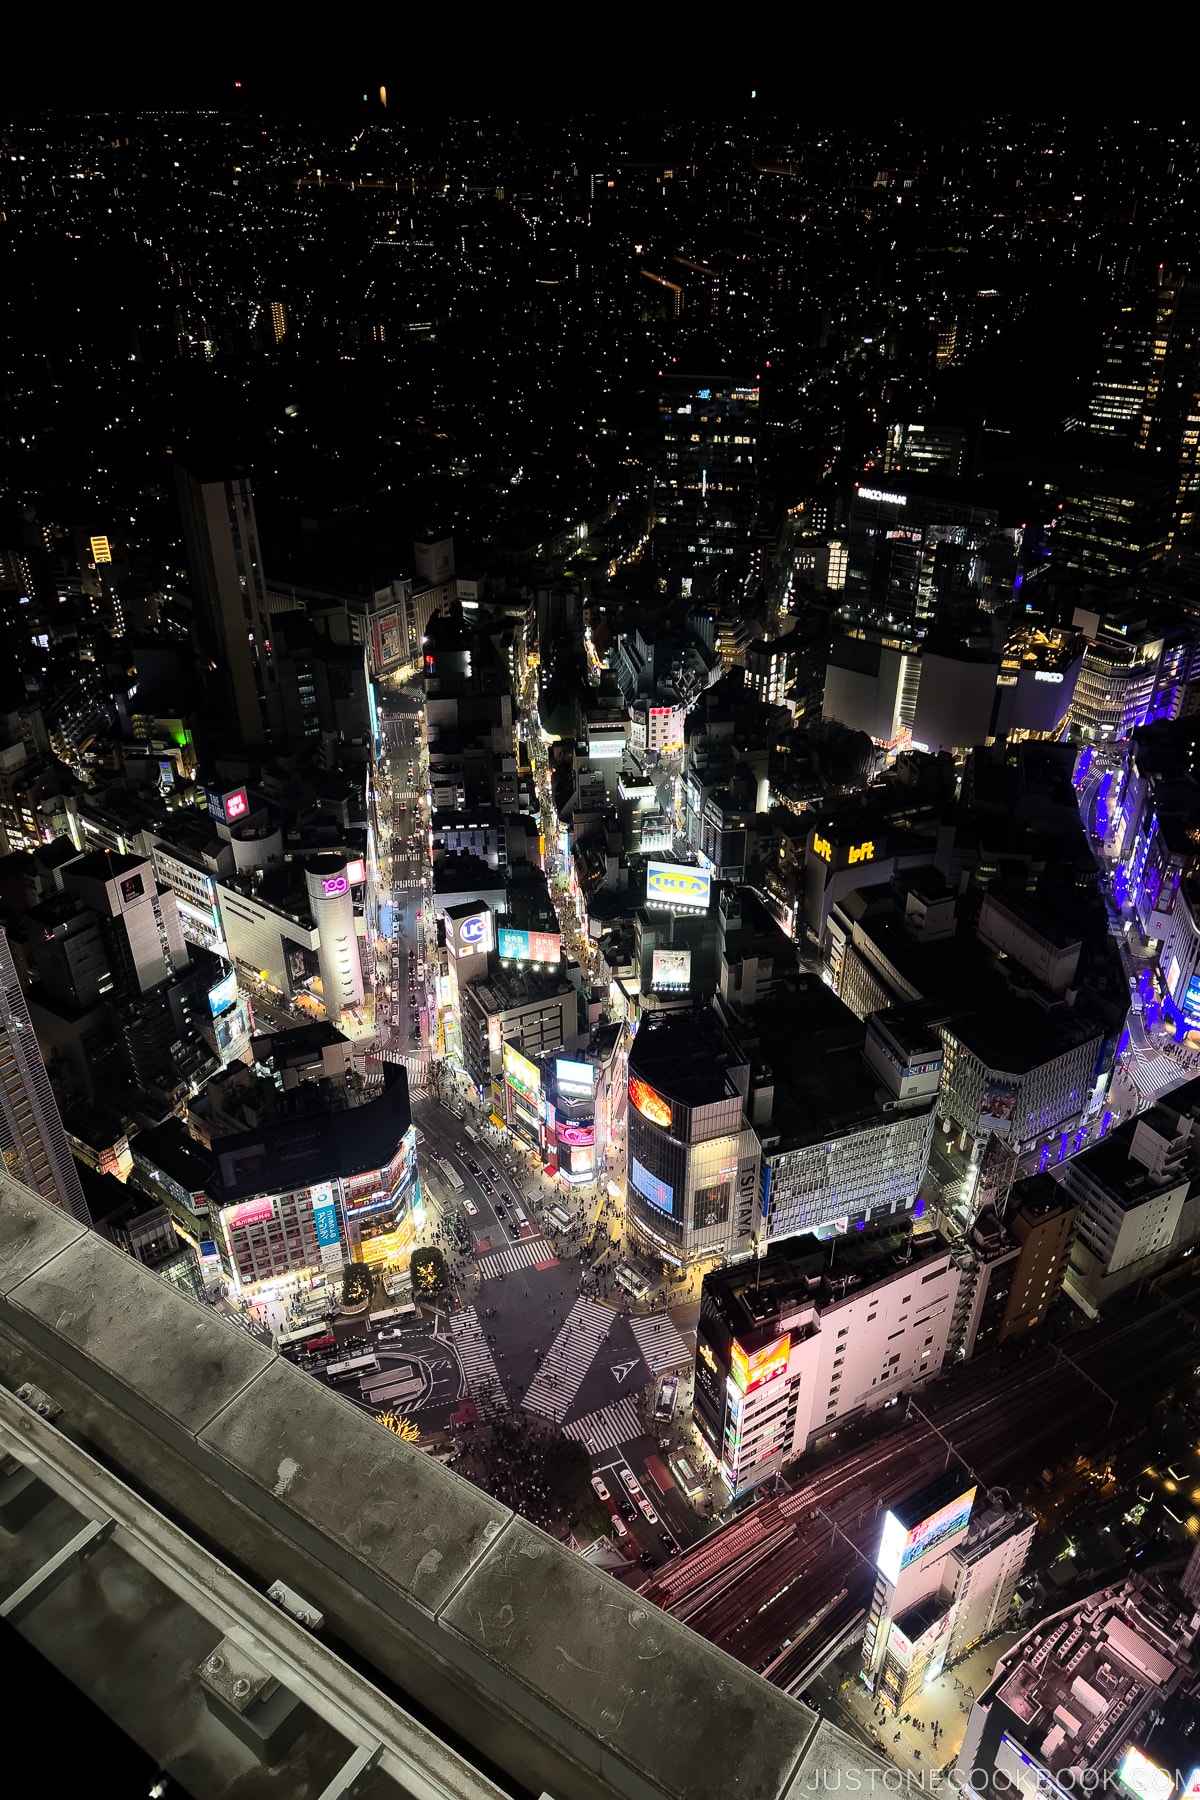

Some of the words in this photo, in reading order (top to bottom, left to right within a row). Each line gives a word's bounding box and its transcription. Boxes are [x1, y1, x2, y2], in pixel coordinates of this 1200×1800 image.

[321, 877, 348, 894] 109
[655, 877, 702, 891] IKEA
[738, 1164, 756, 1239] TSUTAYA
[751, 1357, 786, 1384] アコム
